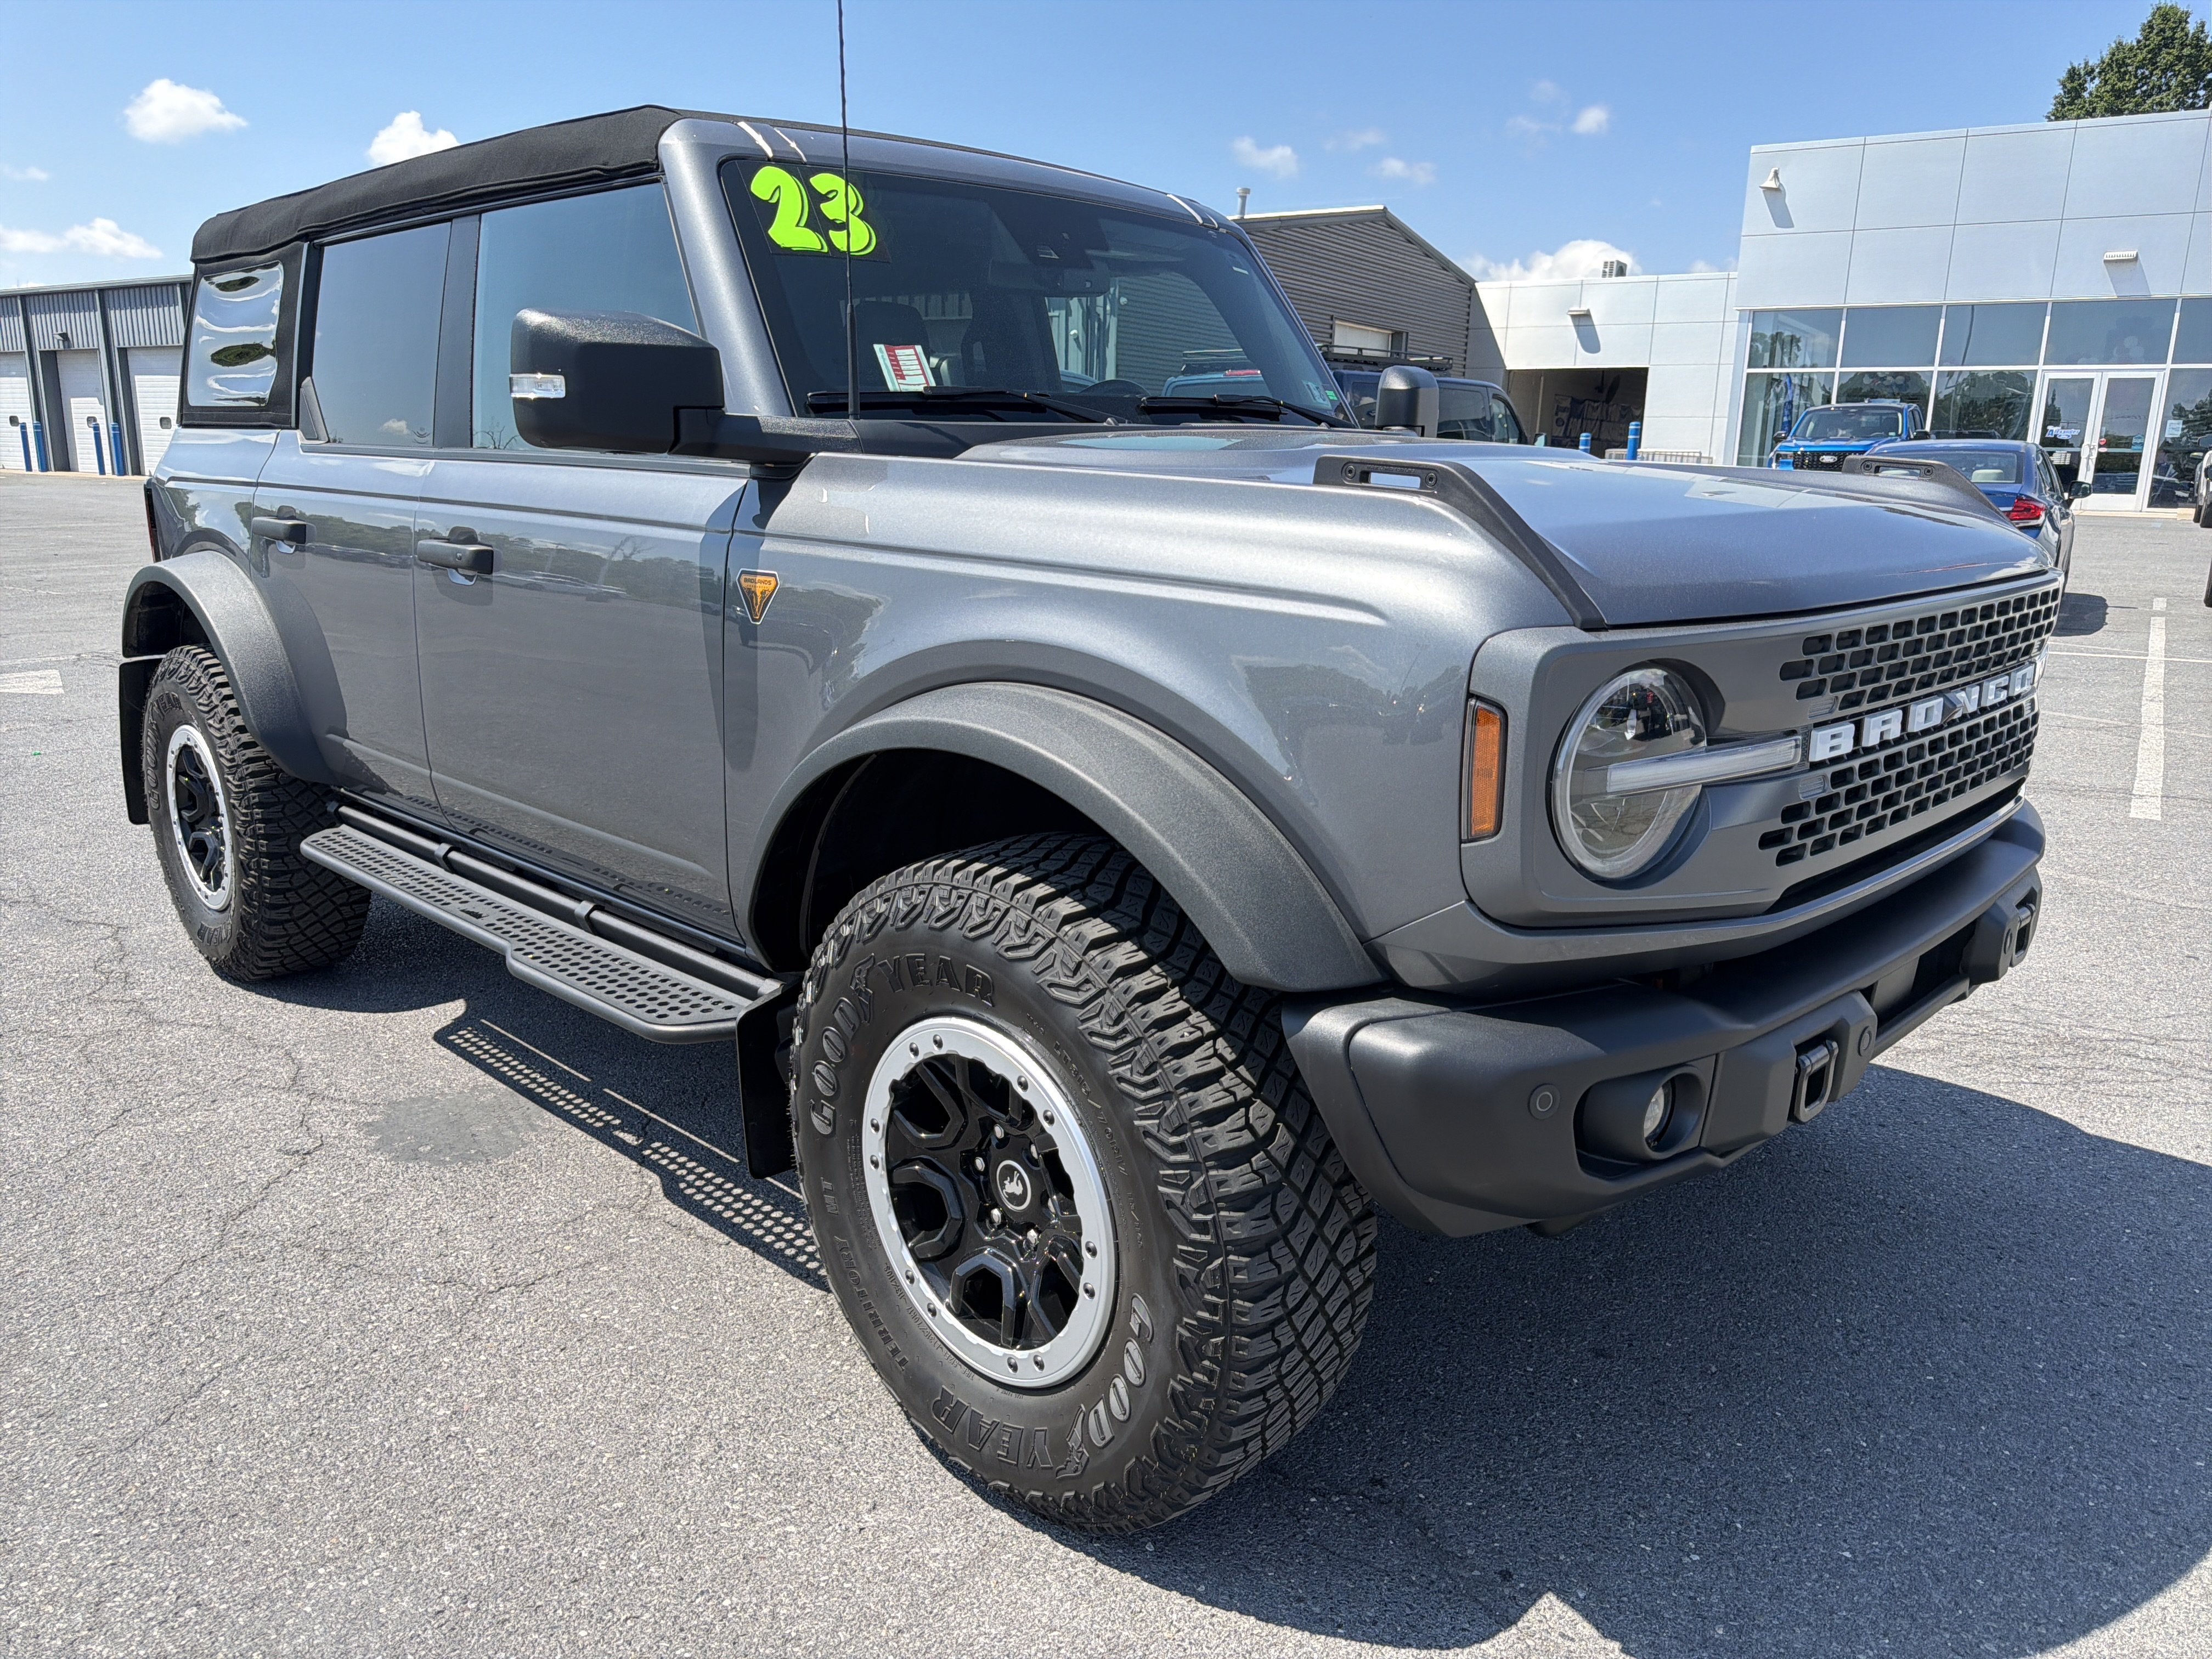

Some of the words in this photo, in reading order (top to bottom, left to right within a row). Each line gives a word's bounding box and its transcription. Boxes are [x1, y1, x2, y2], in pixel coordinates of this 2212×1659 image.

[751, 166, 877, 256] 23
[1808, 662, 2035, 762] BRONCO
[809, 952, 994, 1135] GOODYEAR
[834, 1235, 909, 1372] TERRITORY
[932, 1293, 1154, 1479] GOODYEAR
